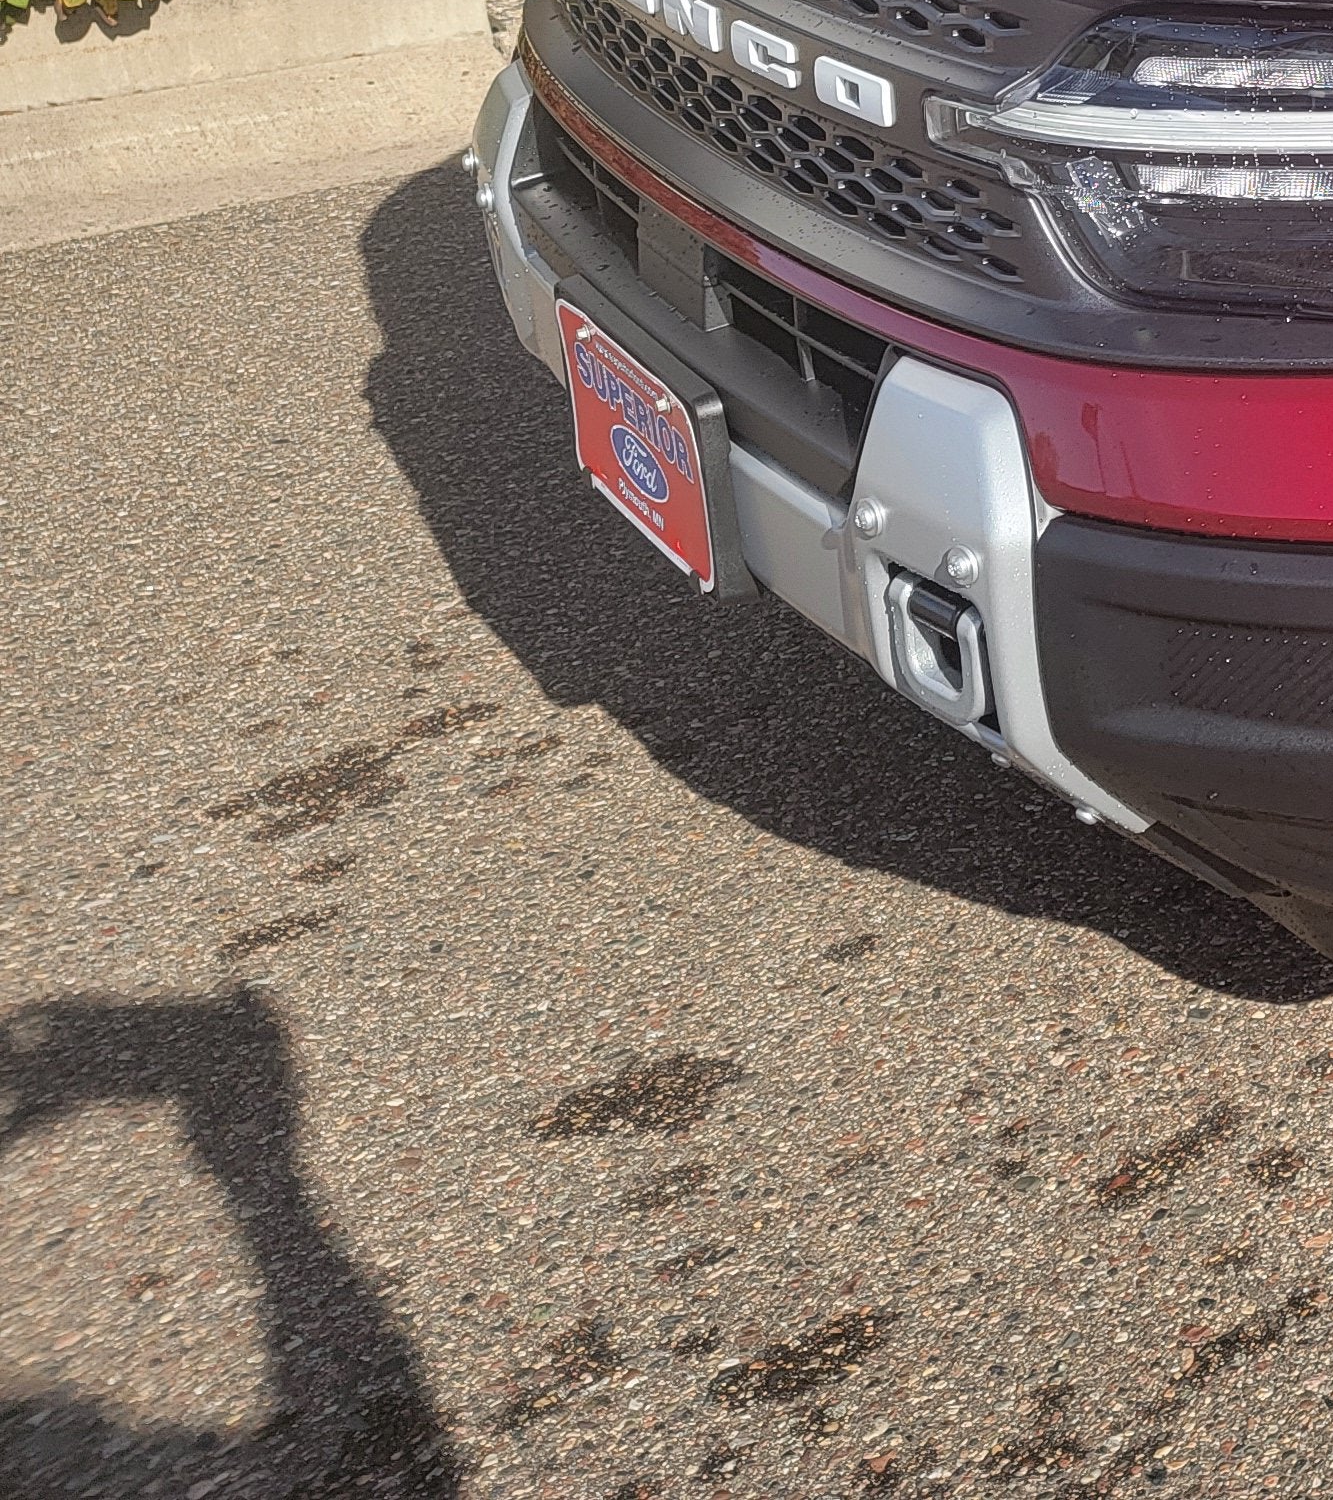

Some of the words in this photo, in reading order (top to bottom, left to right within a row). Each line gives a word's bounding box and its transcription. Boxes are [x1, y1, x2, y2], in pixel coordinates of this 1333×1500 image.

[573, 341, 695, 486] SUPERIOR
[622, 433, 658, 494] Ford
[652, 509, 664, 531] MN
